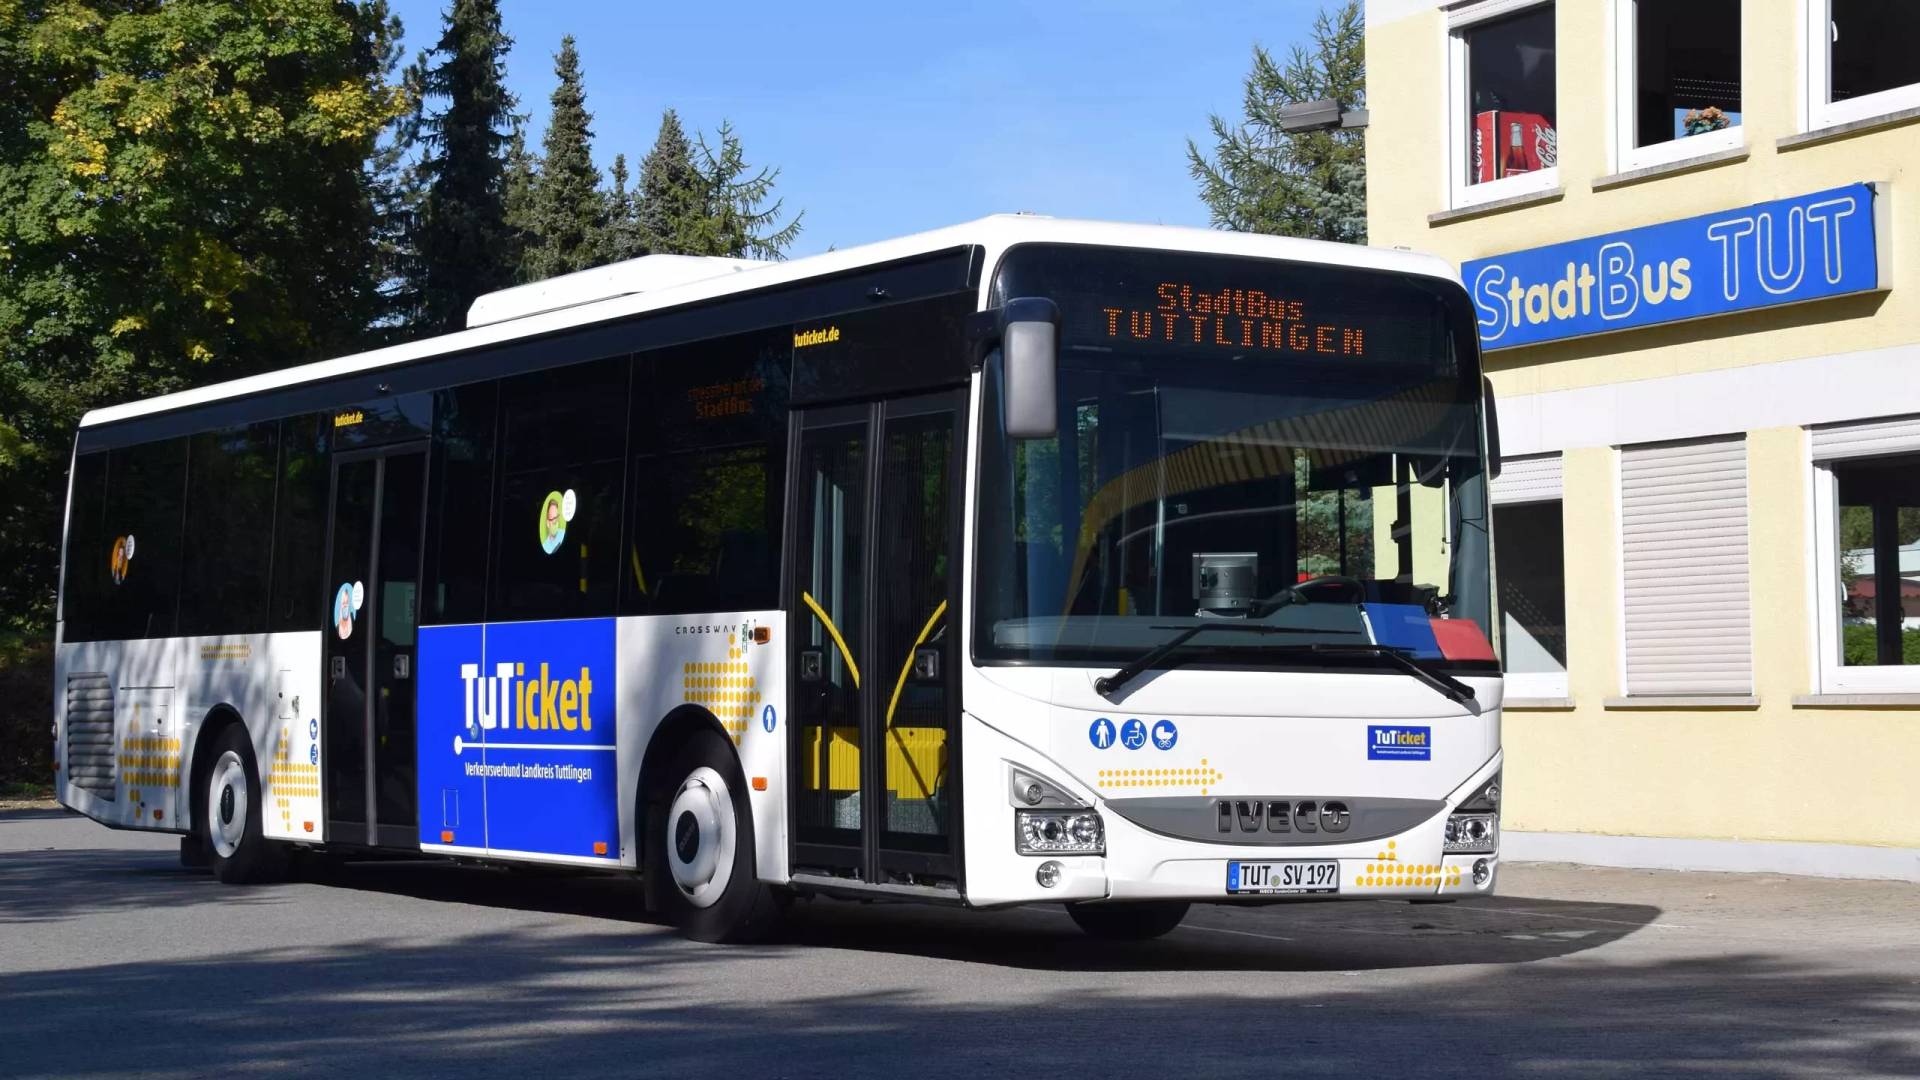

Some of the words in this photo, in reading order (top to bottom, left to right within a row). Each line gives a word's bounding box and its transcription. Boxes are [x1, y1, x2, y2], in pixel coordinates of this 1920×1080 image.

[1475, 241, 1693, 342] StadtBus
[1707, 197, 1856, 302] TUT
[1157, 282, 1304, 321] StadtBus
[794, 326, 840, 348] tuticket.de
[1103, 307, 1364, 356] TUTTLINGEN
[461, 662, 592, 731] TuTicket
[1375, 730, 1426, 745] TuTicket
[465, 761, 521, 779] Verkehrsverbund
[521, 763, 555, 780] Landkreis
[554, 764, 593, 784] Tuttlingen
[1218, 800, 1352, 834] IVECO
[1240, 865, 1271, 886] TUT
[1283, 865, 1304, 886] SV
[1306, 865, 1336, 885] 197
